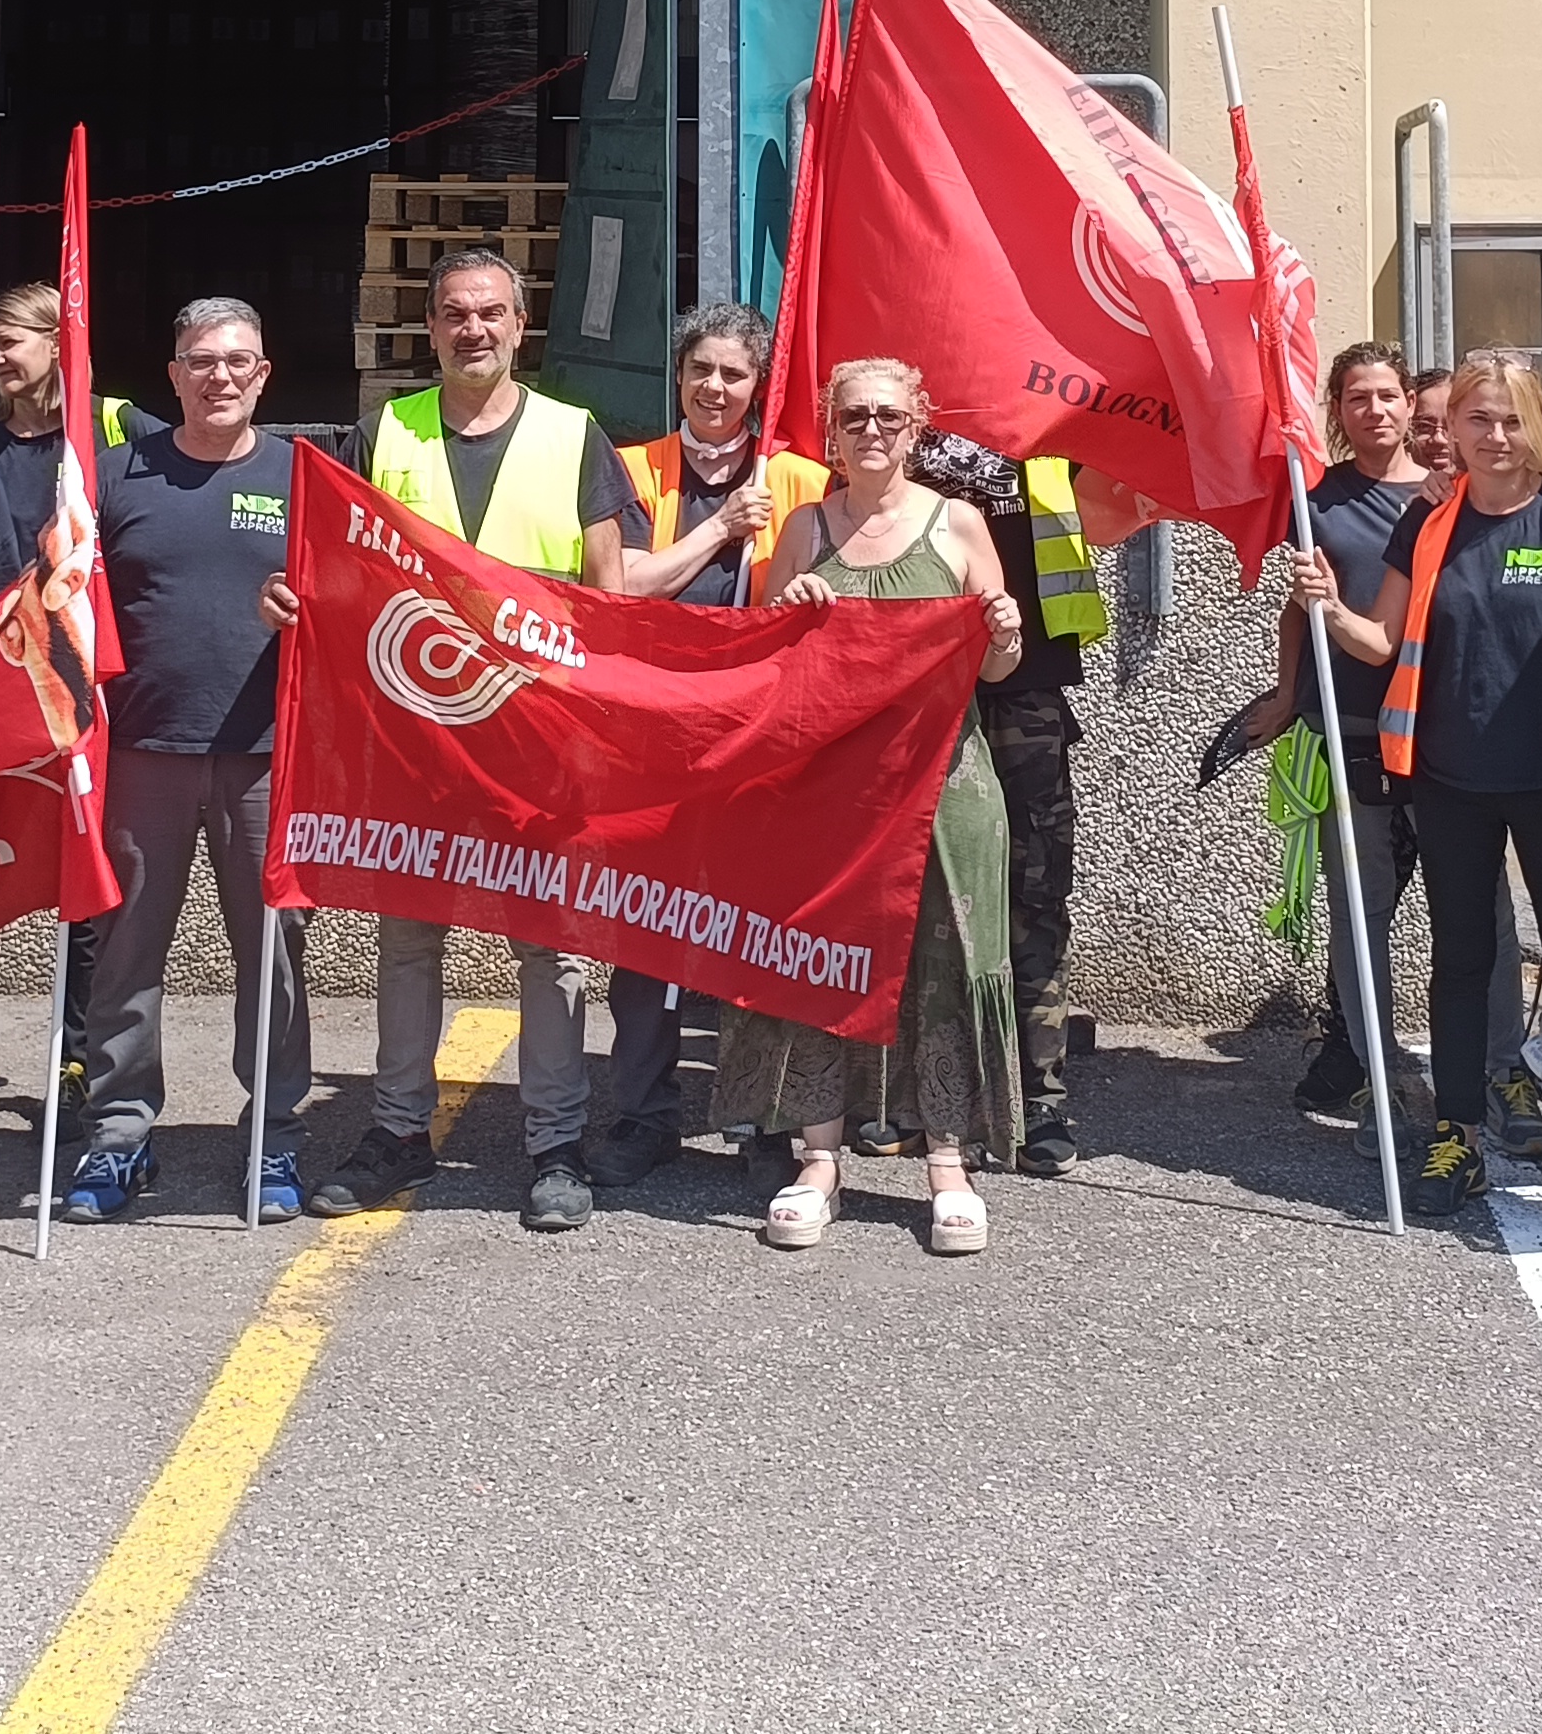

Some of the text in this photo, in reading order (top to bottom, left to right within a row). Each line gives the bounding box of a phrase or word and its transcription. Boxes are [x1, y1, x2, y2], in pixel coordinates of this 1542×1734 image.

[975, 479, 1004, 493] BRAND
[230, 520, 286, 536] EXPRESS
[231, 511, 286, 528] NIPPON
[492, 596, 586, 669] C.G.I.L.
[282, 812, 873, 995] FEDERAZIONE ITALIANA LAVORATORI TRASPORTI
